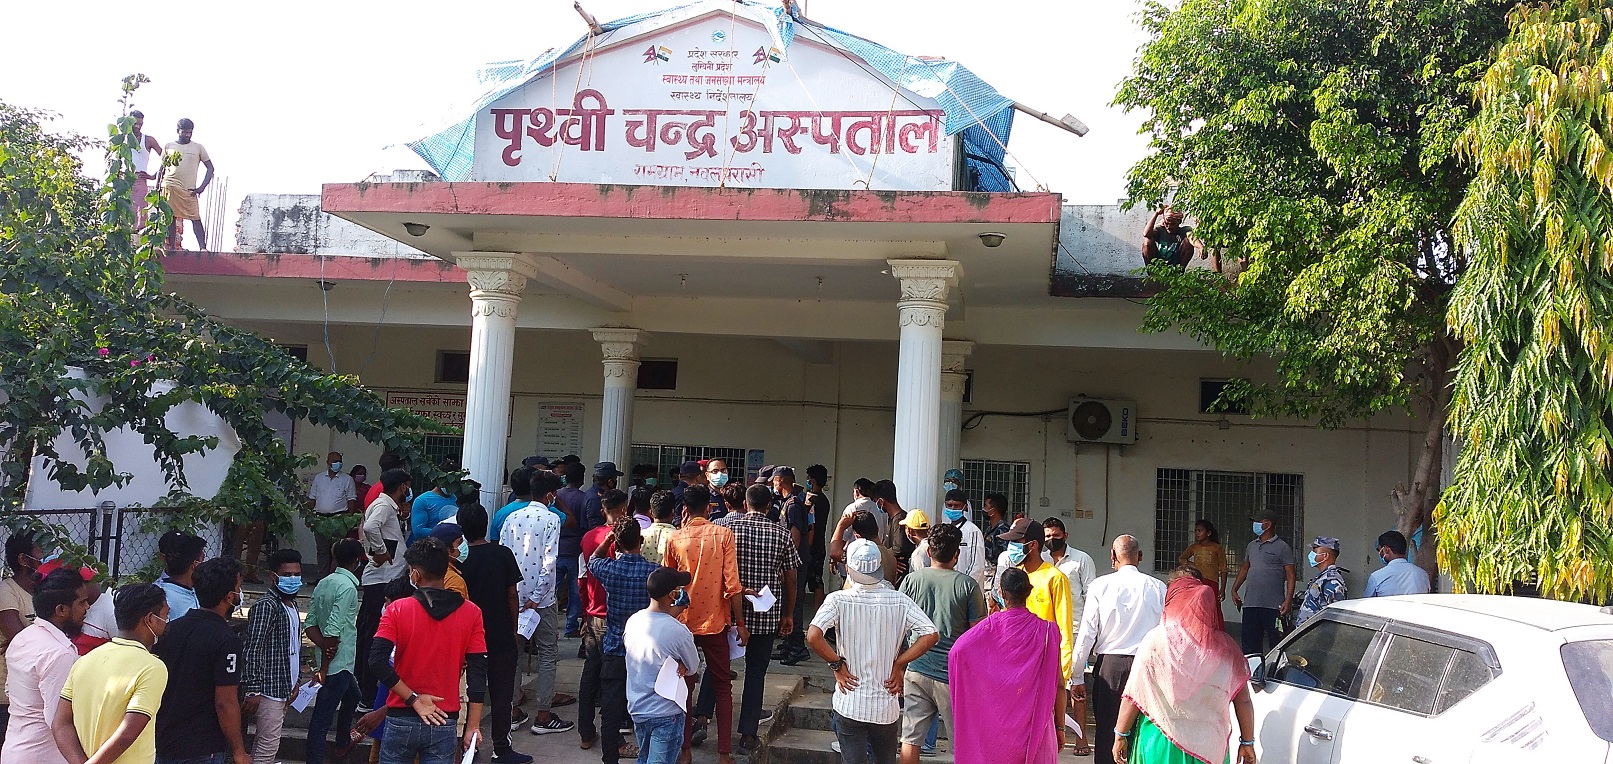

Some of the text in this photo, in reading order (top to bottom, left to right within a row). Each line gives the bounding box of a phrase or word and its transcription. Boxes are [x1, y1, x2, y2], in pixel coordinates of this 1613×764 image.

[687, 47, 739, 60] प्रदेश सरकार
[715, 61, 733, 73] प्रदेश
[662, 74, 688, 85] स्वास्थ्य
[689, 75, 703, 85] तथा
[737, 75, 766, 86] मन्त्रालय
[670, 91, 702, 102] स्वास्थ्य
[490, 88, 946, 167] पृथ्वी चन्द्र अस्पताल
[390, 396, 418, 406] अस्पताल
[457, 411, 466, 422] सु
[1121, 408, 1129, 436] BEKO
[226, 653, 237, 673] 3
